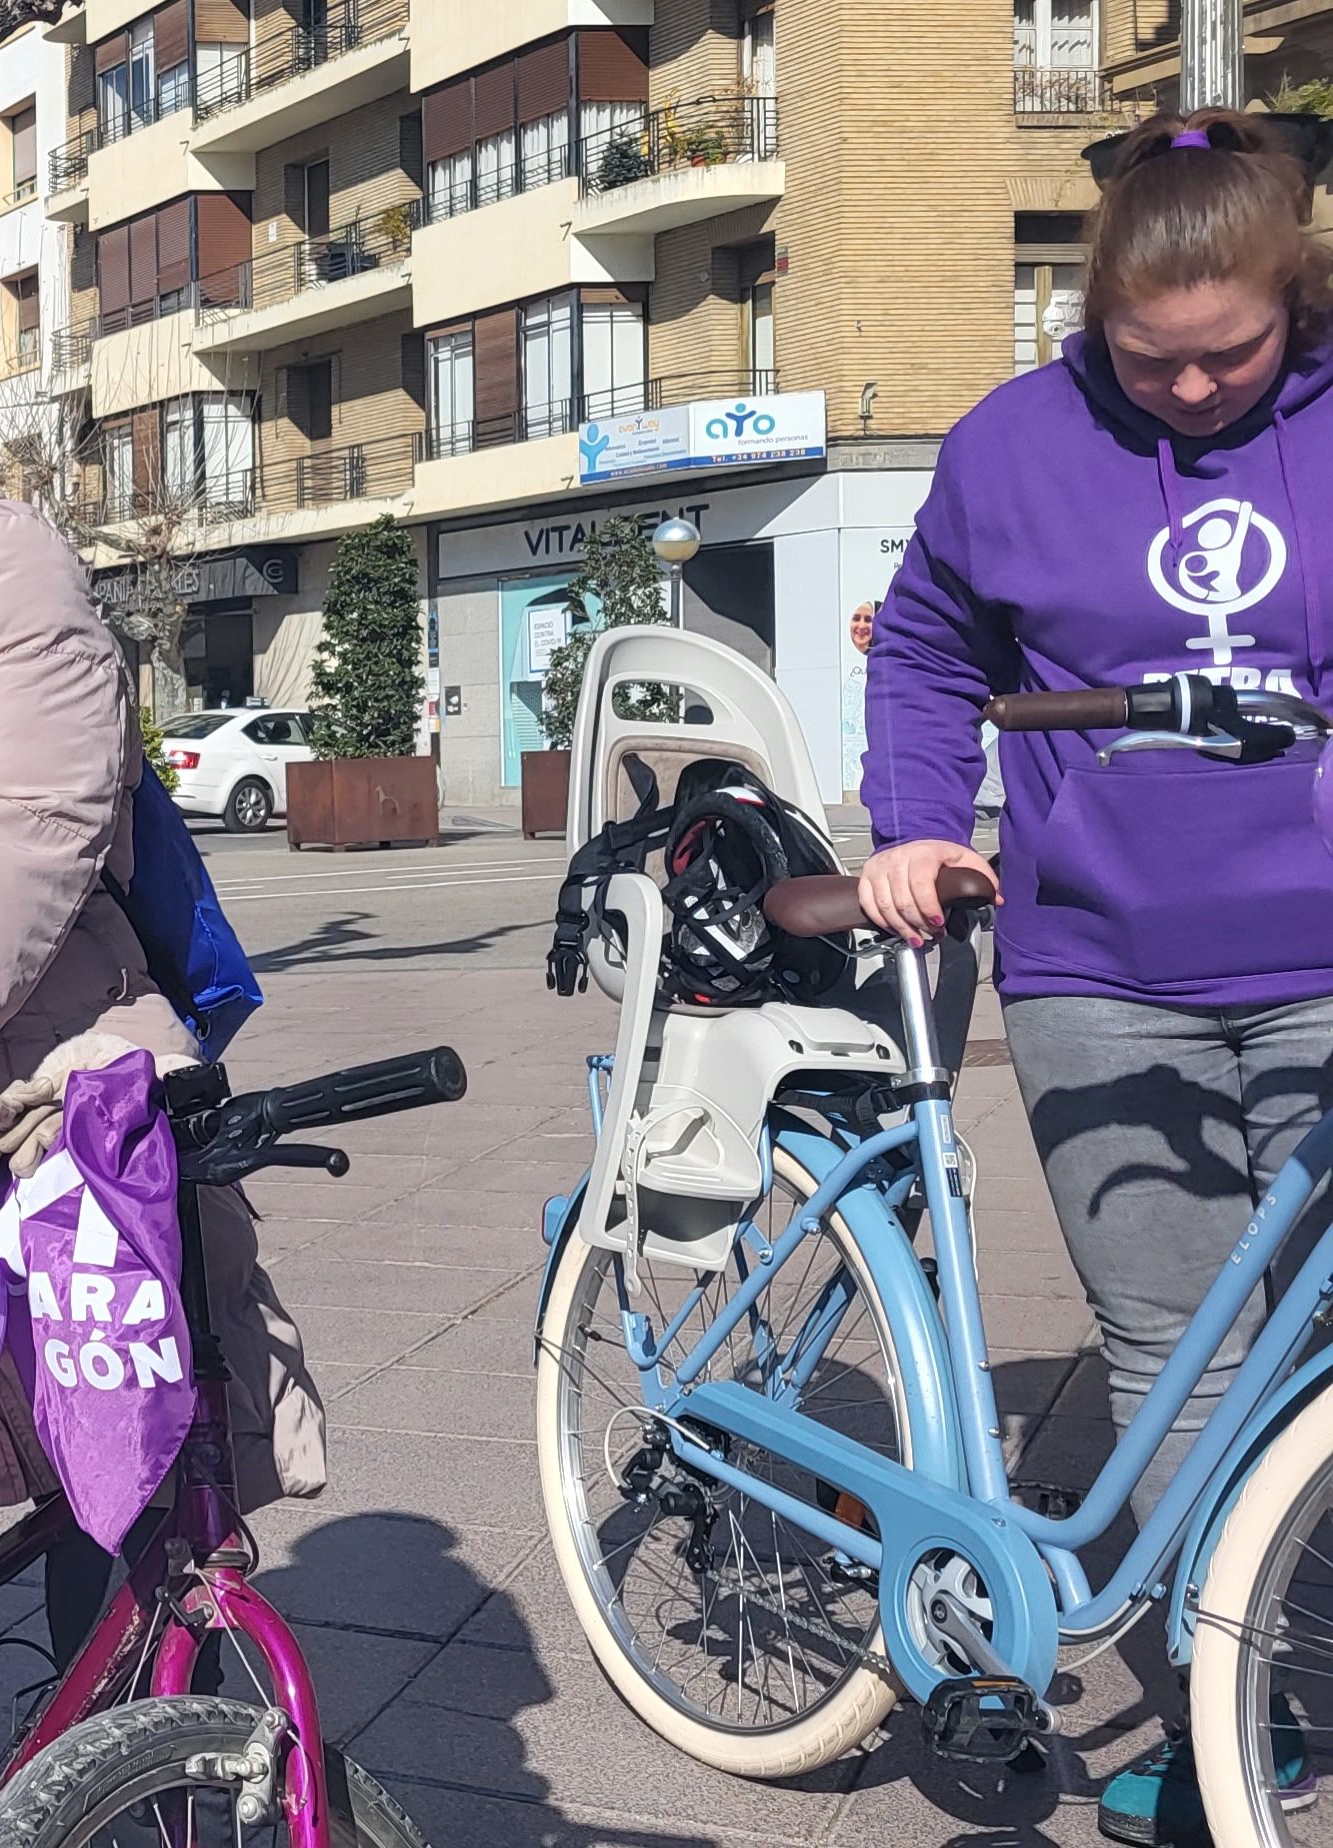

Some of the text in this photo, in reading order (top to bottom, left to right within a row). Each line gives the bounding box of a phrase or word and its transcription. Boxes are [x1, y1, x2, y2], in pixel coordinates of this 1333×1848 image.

[737, 434, 808, 446] formando personas
[1230, 1193, 1277, 1265] ELOPS
[27, 1271, 166, 1325] ARA
[44, 1327, 183, 1391] GÓN
